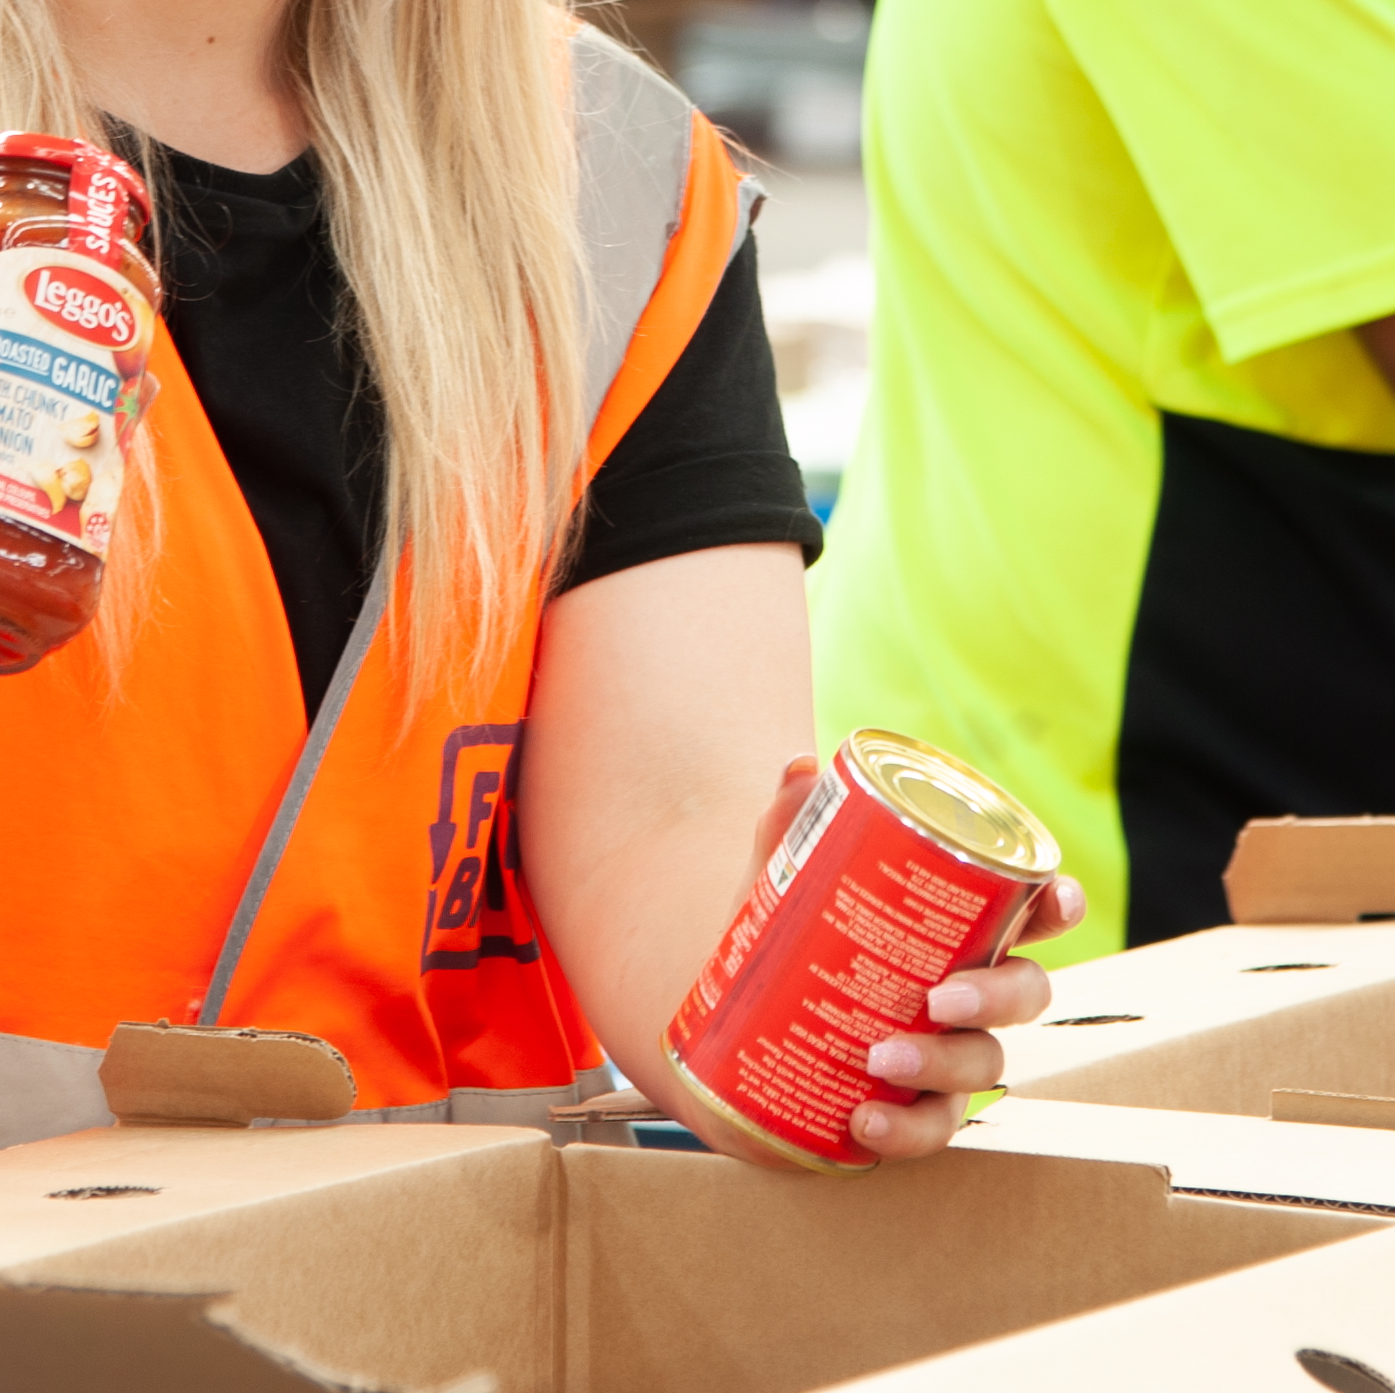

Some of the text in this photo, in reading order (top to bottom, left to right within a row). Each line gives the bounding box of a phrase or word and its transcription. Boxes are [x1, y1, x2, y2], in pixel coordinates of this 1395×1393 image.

[85, 172, 118, 255] SAUCES
[34, 269, 130, 342] Leggo's
[14, 384, 69, 421] CHUNKY
[51, 356, 117, 408] GARLIC
[761, 1054, 776, 1068] the
[767, 1102, 783, 1116] the
